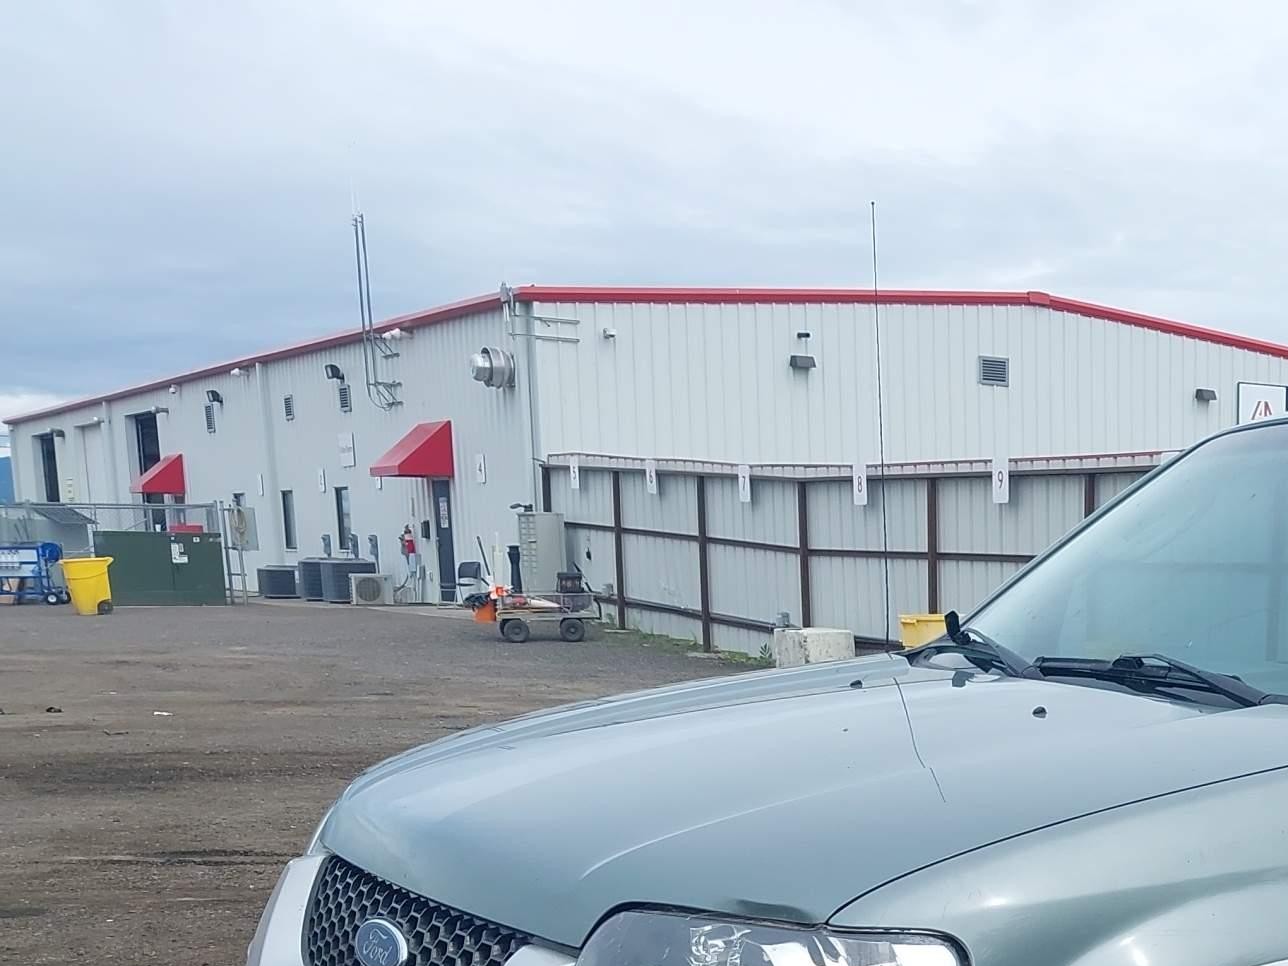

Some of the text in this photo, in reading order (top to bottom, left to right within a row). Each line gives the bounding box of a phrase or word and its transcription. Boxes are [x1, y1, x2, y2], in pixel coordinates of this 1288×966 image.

[857, 475, 863, 493] 8
[997, 470, 1004, 489] 9
[363, 928, 393, 966] Ford
